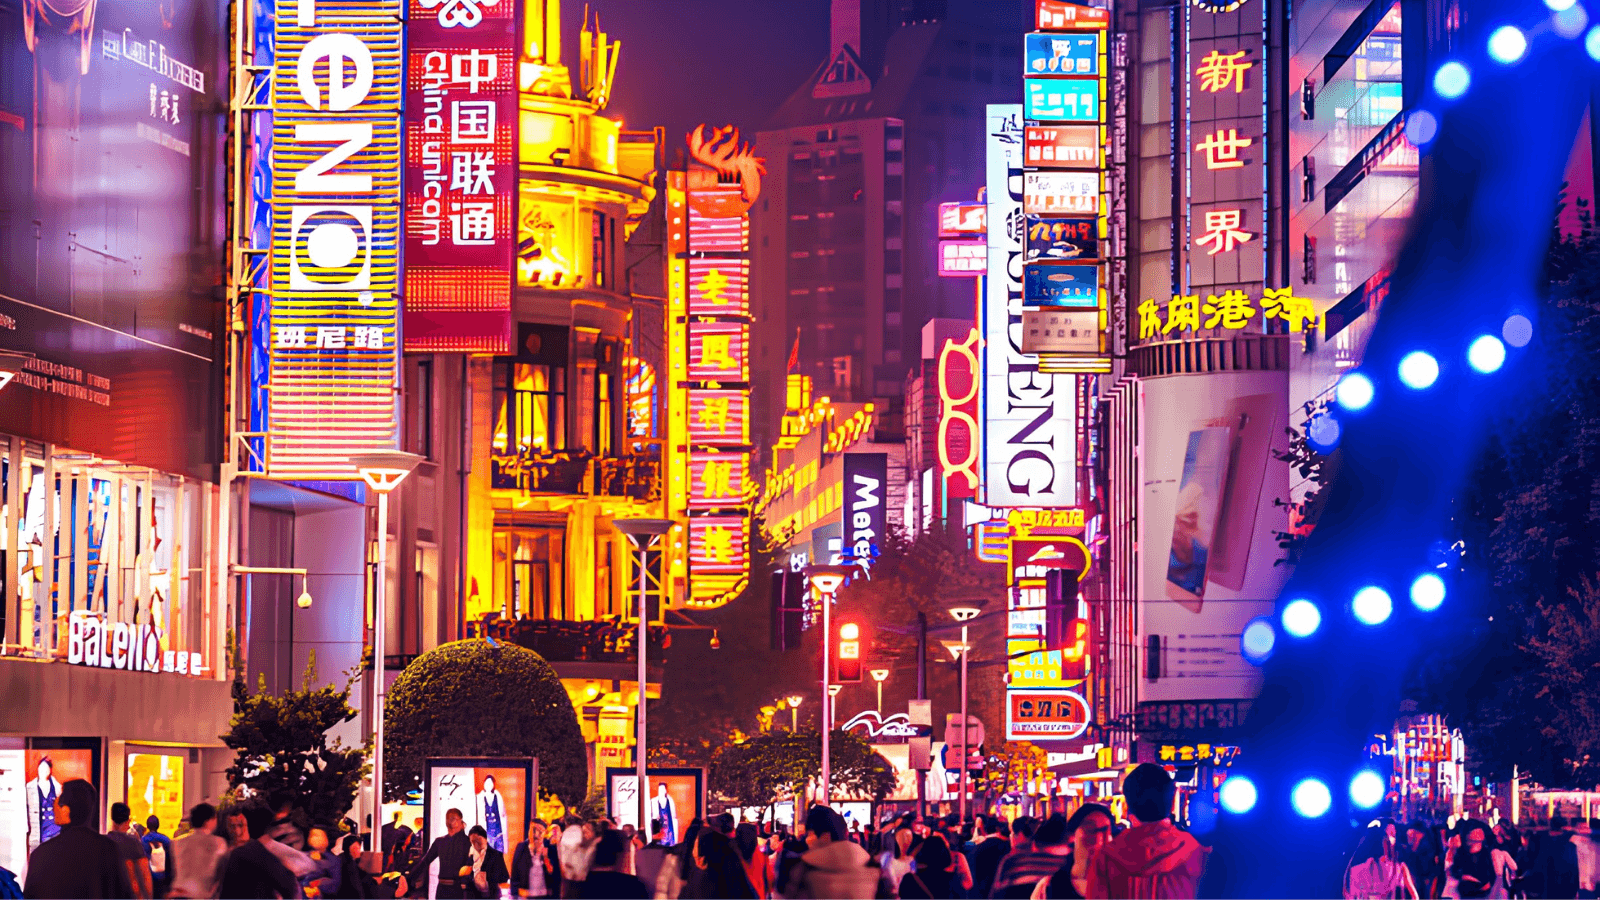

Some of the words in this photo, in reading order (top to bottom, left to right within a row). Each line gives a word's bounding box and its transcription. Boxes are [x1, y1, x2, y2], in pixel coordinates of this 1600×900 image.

[421, 142, 448, 246] unicom
[450, 48, 497, 246] 中国联通
[1195, 50, 1253, 256] 新世界
